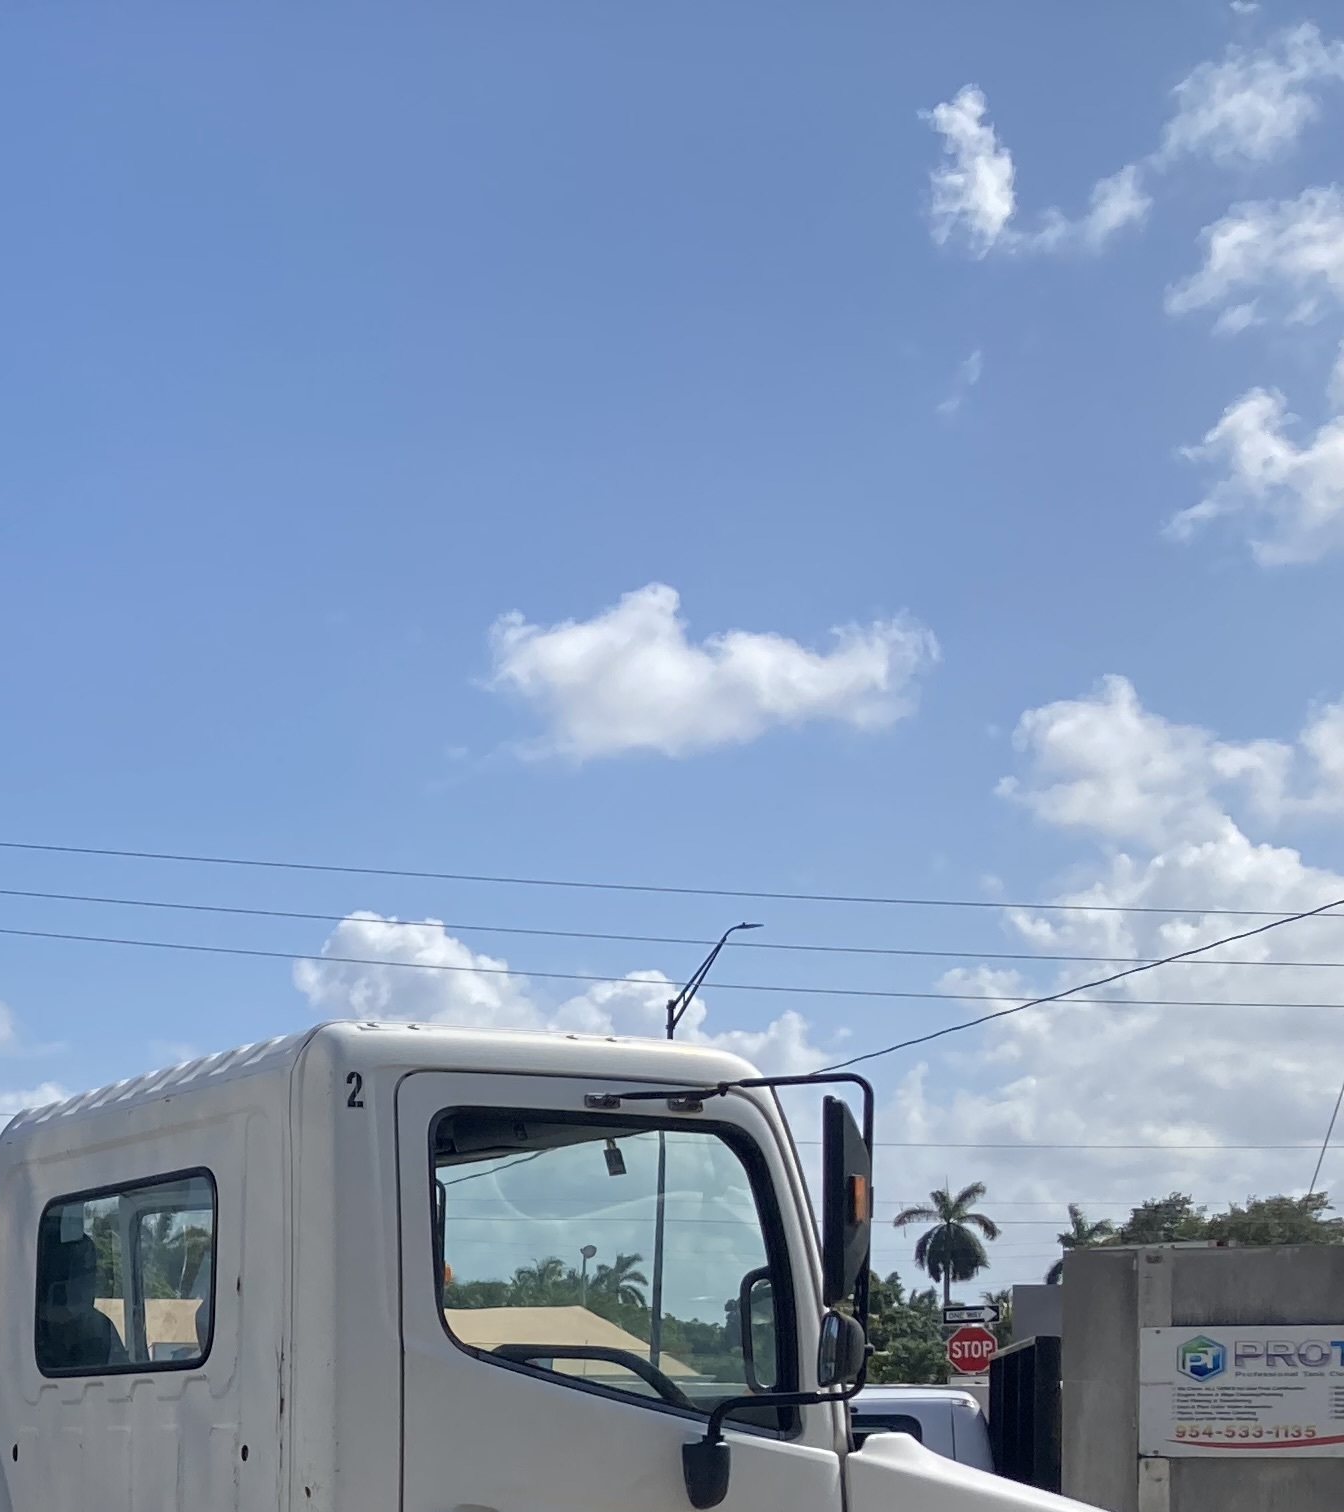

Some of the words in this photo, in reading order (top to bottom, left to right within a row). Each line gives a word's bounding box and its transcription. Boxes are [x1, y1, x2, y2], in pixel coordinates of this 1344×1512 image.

[346, 1071, 364, 1108] 2
[948, 1311, 964, 1319] ONE
[952, 1340, 993, 1359] STOP
[1174, 1424, 1317, 1439] 954-533-1135
